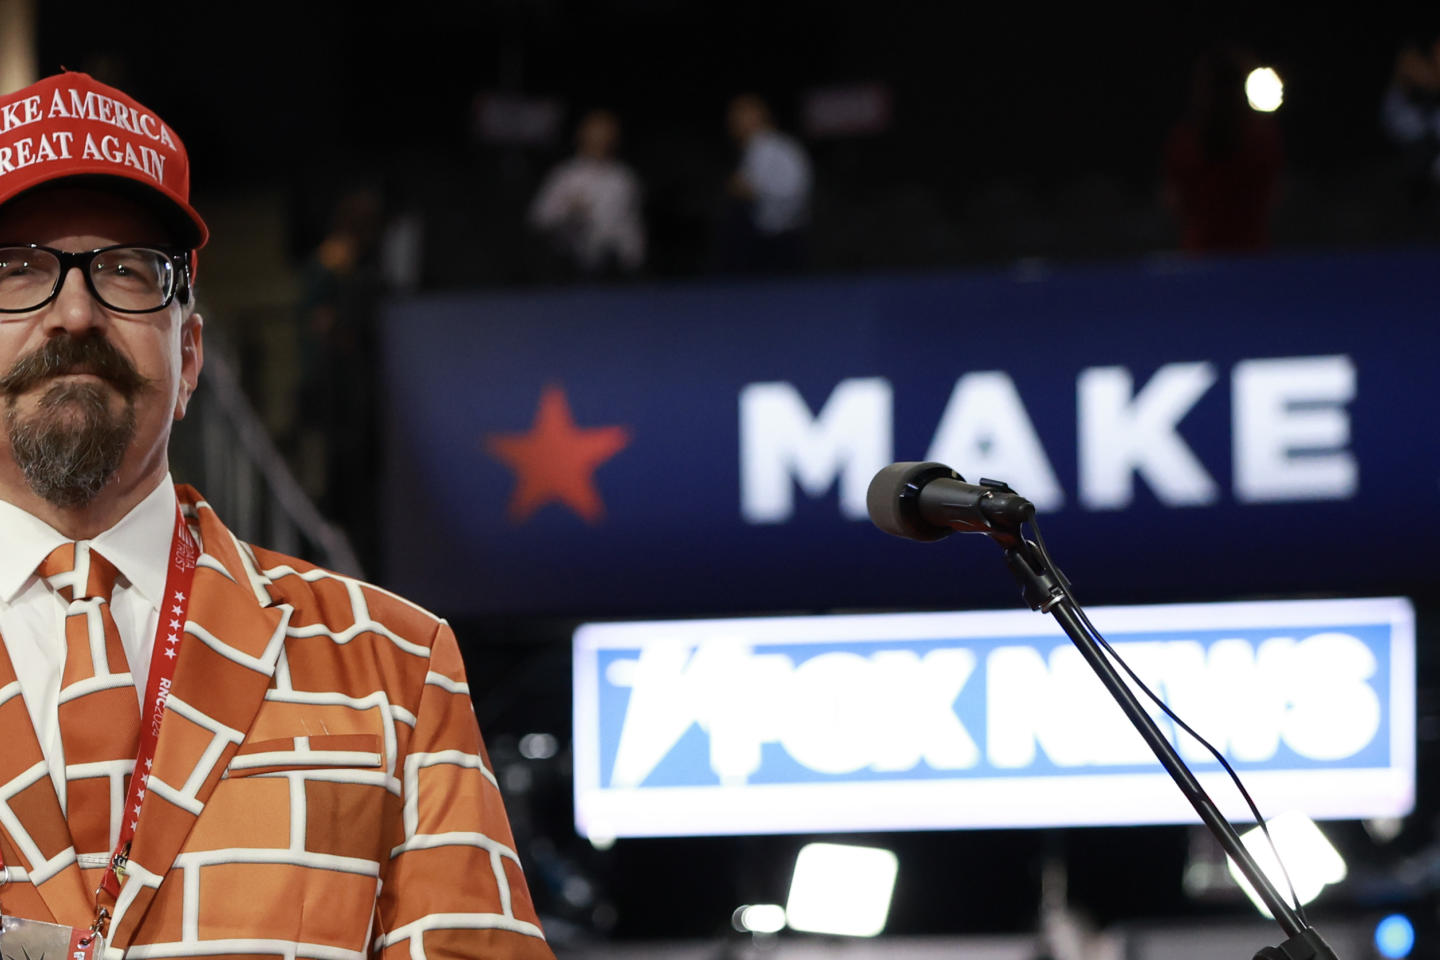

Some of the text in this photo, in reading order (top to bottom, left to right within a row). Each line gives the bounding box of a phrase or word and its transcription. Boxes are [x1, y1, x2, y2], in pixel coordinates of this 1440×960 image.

[47, 88, 177, 152] AMERICA
[82, 132, 166, 185] AGAIN
[739, 353, 1358, 524] MAKE
[708, 634, 1380, 775] FOX NEWS
